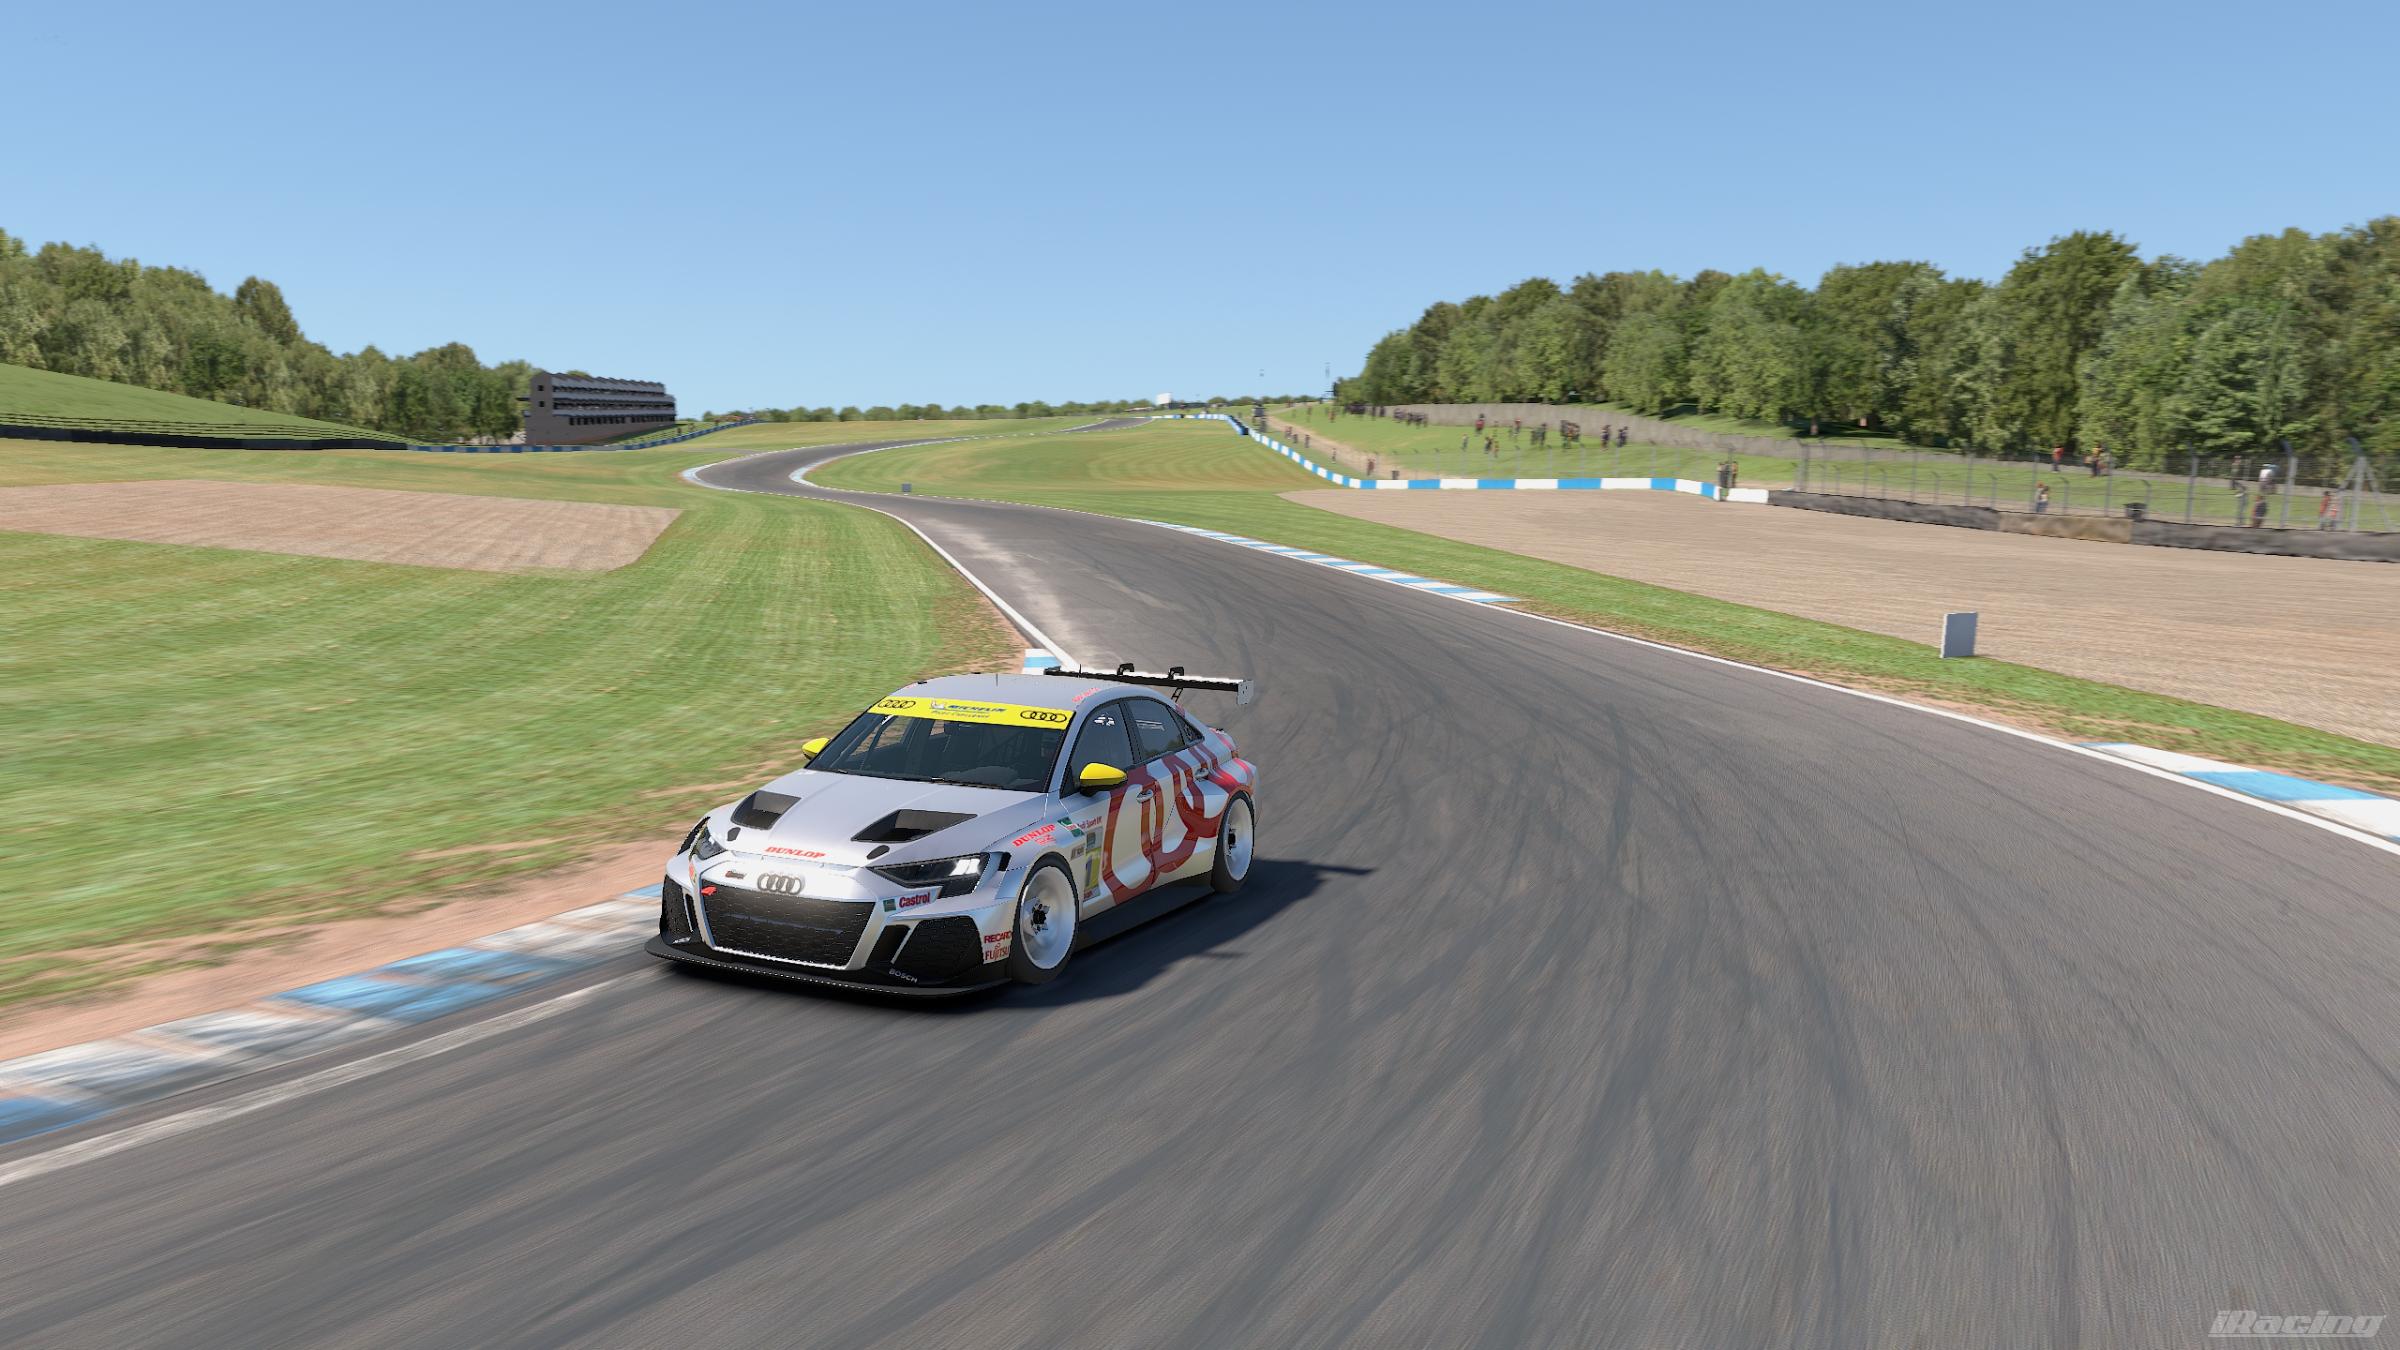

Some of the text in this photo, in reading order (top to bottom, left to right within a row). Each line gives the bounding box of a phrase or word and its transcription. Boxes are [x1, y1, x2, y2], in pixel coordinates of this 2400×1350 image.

[1012, 824, 1056, 847] DUNLOP
[765, 846, 826, 858] DUNLOP
[899, 892, 930, 908] Castrol
[889, 968, 918, 983] BOSCH
